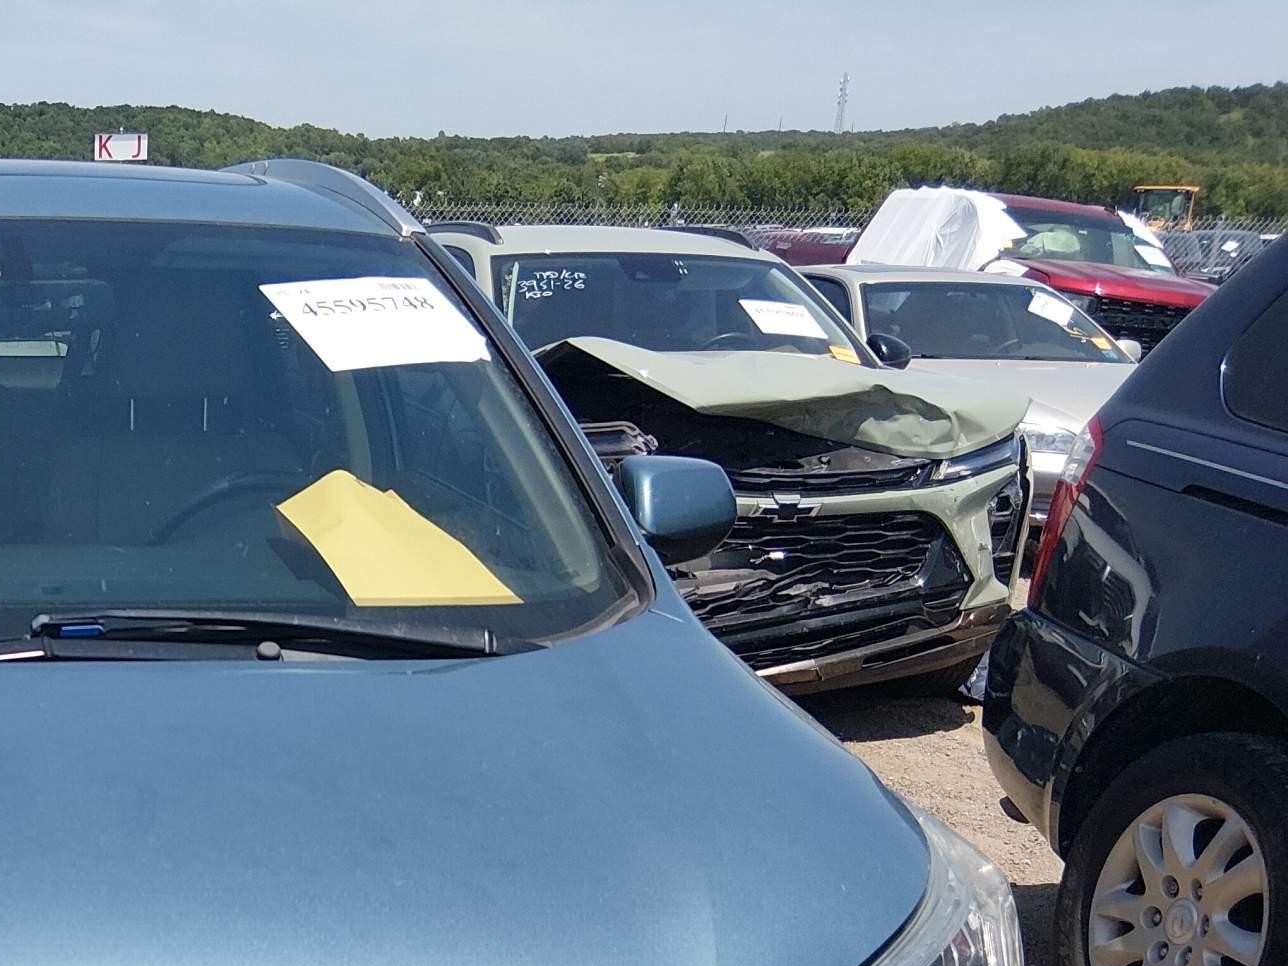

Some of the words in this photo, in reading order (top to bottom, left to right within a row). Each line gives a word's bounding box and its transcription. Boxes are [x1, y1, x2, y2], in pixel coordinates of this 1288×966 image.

[98, 135, 113, 159] K
[131, 135, 142, 159] J
[301, 295, 435, 317] 45595748
